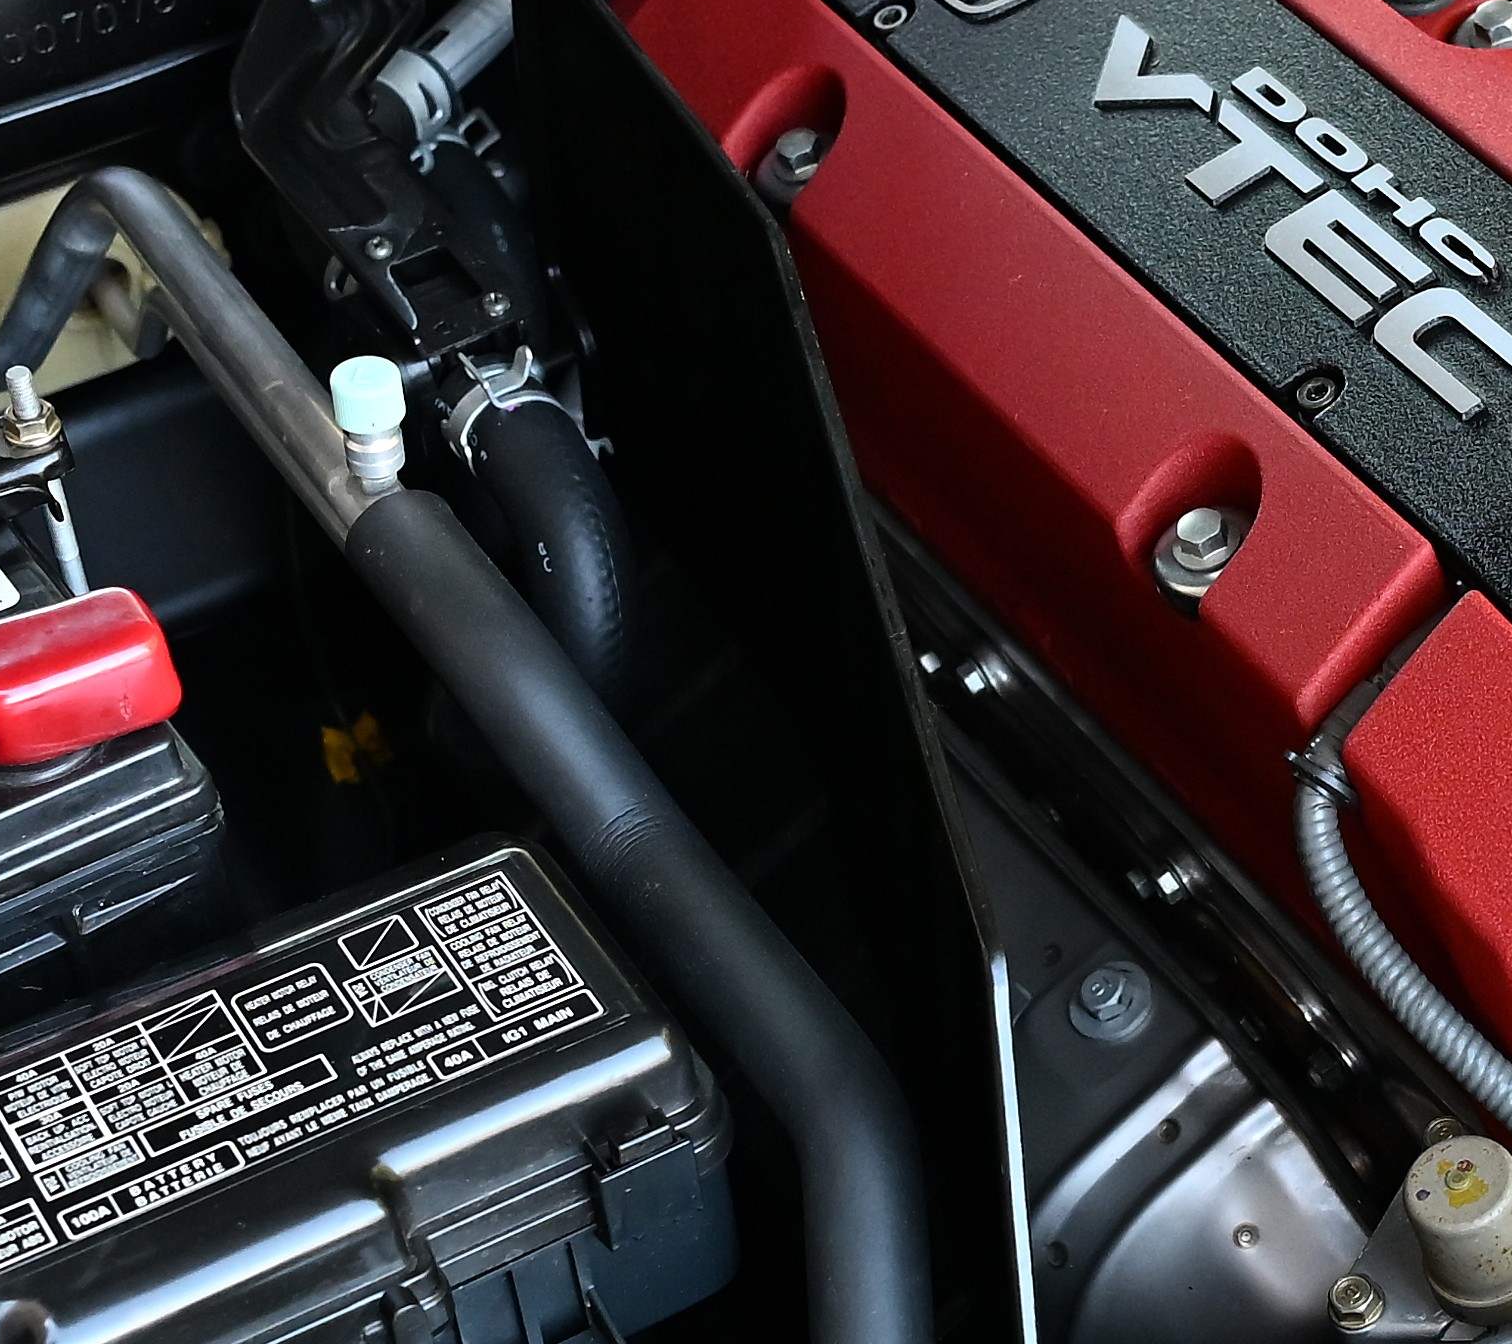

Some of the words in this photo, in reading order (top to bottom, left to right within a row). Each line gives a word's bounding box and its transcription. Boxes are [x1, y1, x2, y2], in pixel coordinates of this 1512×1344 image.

[1231, 66, 1502, 284] DOHC
[498, 975, 535, 998] RELAIS
[535, 968, 552, 982] DE
[264, 1028, 282, 1041] DE
[281, 1004, 337, 1034] CHAUFFAGE
[441, 1047, 474, 1069] 40A
[531, 1004, 575, 1031] MAIN
[193, 1045, 217, 1061] 40A
[177, 1113, 227, 1141] FUSIBLE
[229, 1104, 248, 1119] DE
[250, 1080, 305, 1110] SECOURS
[194, 1096, 234, 1120] SPARE
[235, 1079, 275, 1102] FUSES
[127, 1151, 219, 1198] BATTERY
[133, 1161, 226, 1208] BATTERIE
[70, 1203, 113, 1229] 100A
